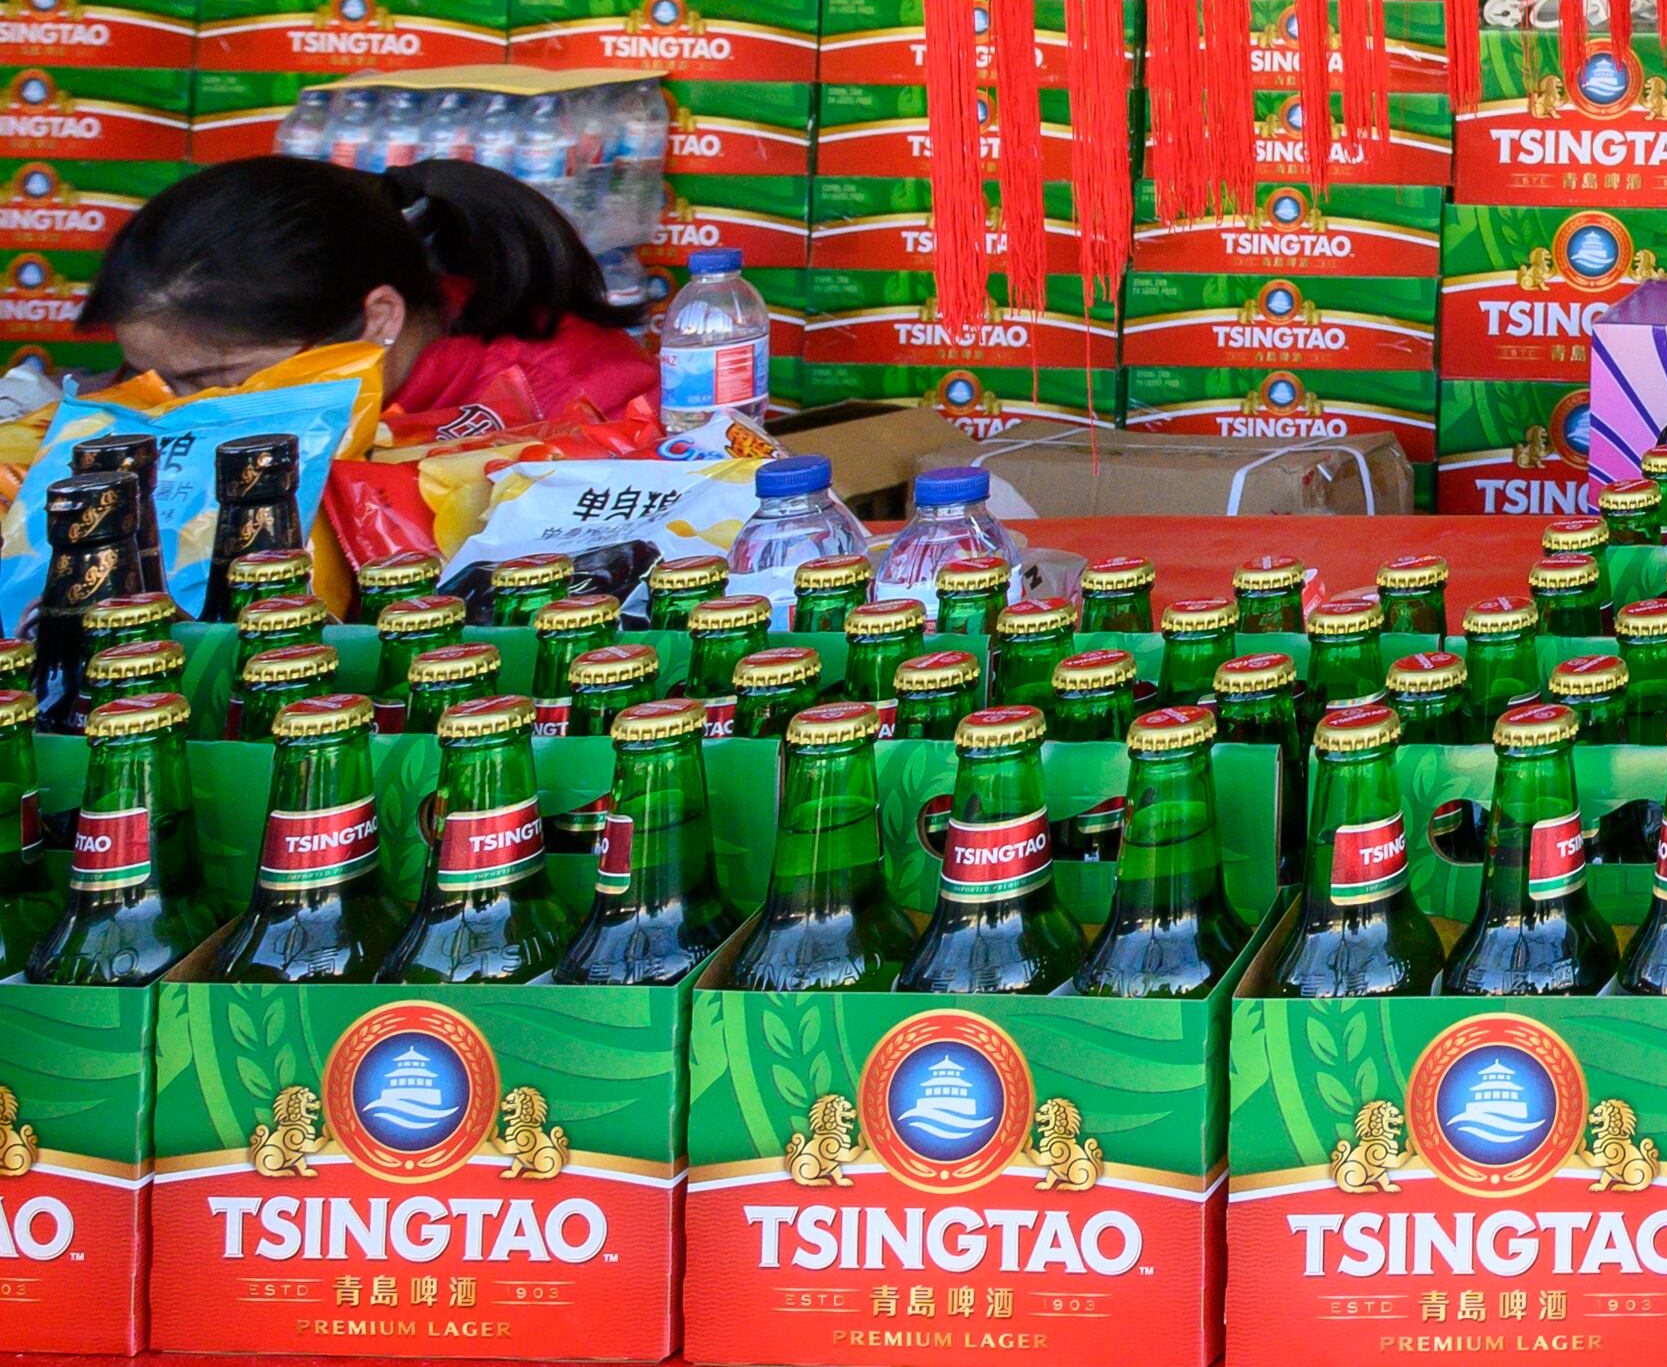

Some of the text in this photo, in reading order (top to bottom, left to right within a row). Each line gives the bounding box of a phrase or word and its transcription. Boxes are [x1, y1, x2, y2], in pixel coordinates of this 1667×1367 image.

[1562, 173, 1642, 190] 青島啤酒
[1212, 326, 1346, 350] TSINGTAO
[954, 834, 1046, 866] TSINGTAO
[208, 1195, 608, 1263] TSINGTAO
[743, 1205, 1142, 1275] TSINGTAO
[248, 1282, 309, 1297] ESTD
[332, 1274, 478, 1308] 青島啤酒
[785, 1294, 846, 1307] ESTD
[870, 1286, 1014, 1319] 青島啤酒
[1418, 1289, 1567, 1323] 青島啤酒
[295, 1318, 512, 1338] PREMIUM LAGER
[831, 1330, 1048, 1350] PREMIUM LAGER
[1379, 1335, 1603, 1353] PREMIUM LAGER
